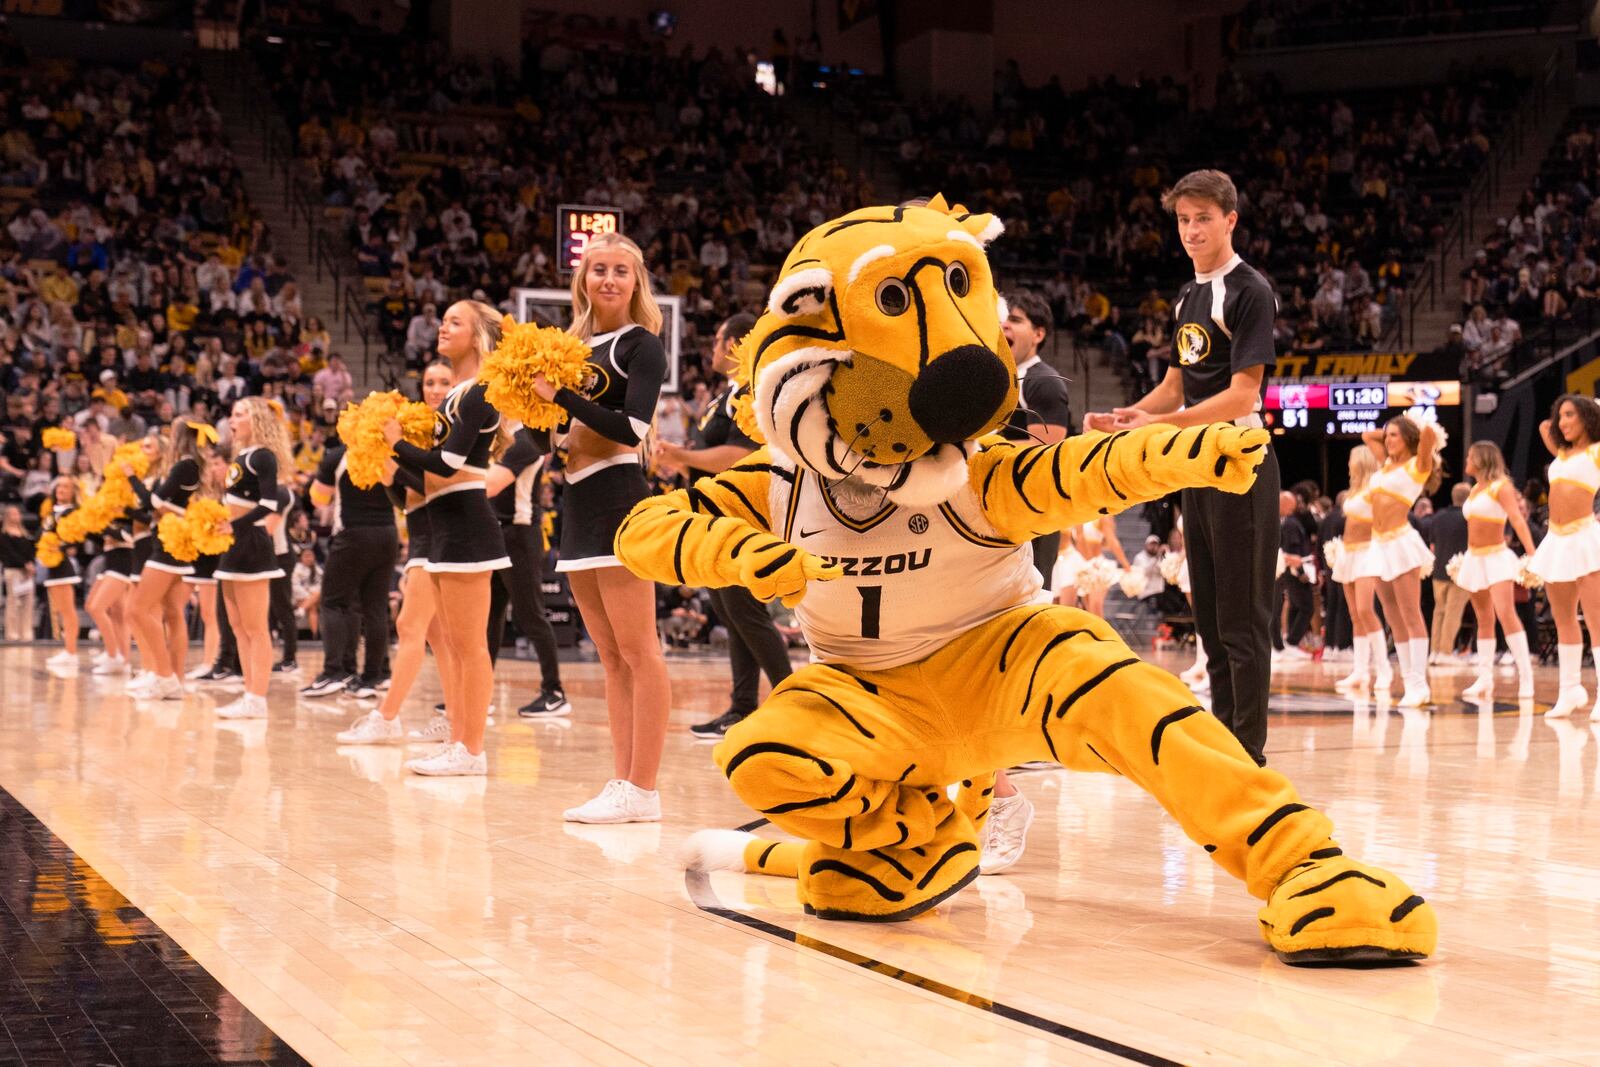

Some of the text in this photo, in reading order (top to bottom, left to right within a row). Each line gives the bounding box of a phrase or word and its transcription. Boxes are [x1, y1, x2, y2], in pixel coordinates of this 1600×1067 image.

[570, 213, 616, 234] 11:20
[1314, 351, 1417, 376] FAMILY
[1334, 388, 1384, 405] 11:20
[1283, 408, 1309, 428] 51
[1357, 410, 1380, 420] HALF
[909, 514, 928, 533] SEC
[810, 548, 932, 576] ZZOU
[856, 585, 882, 639] 1
